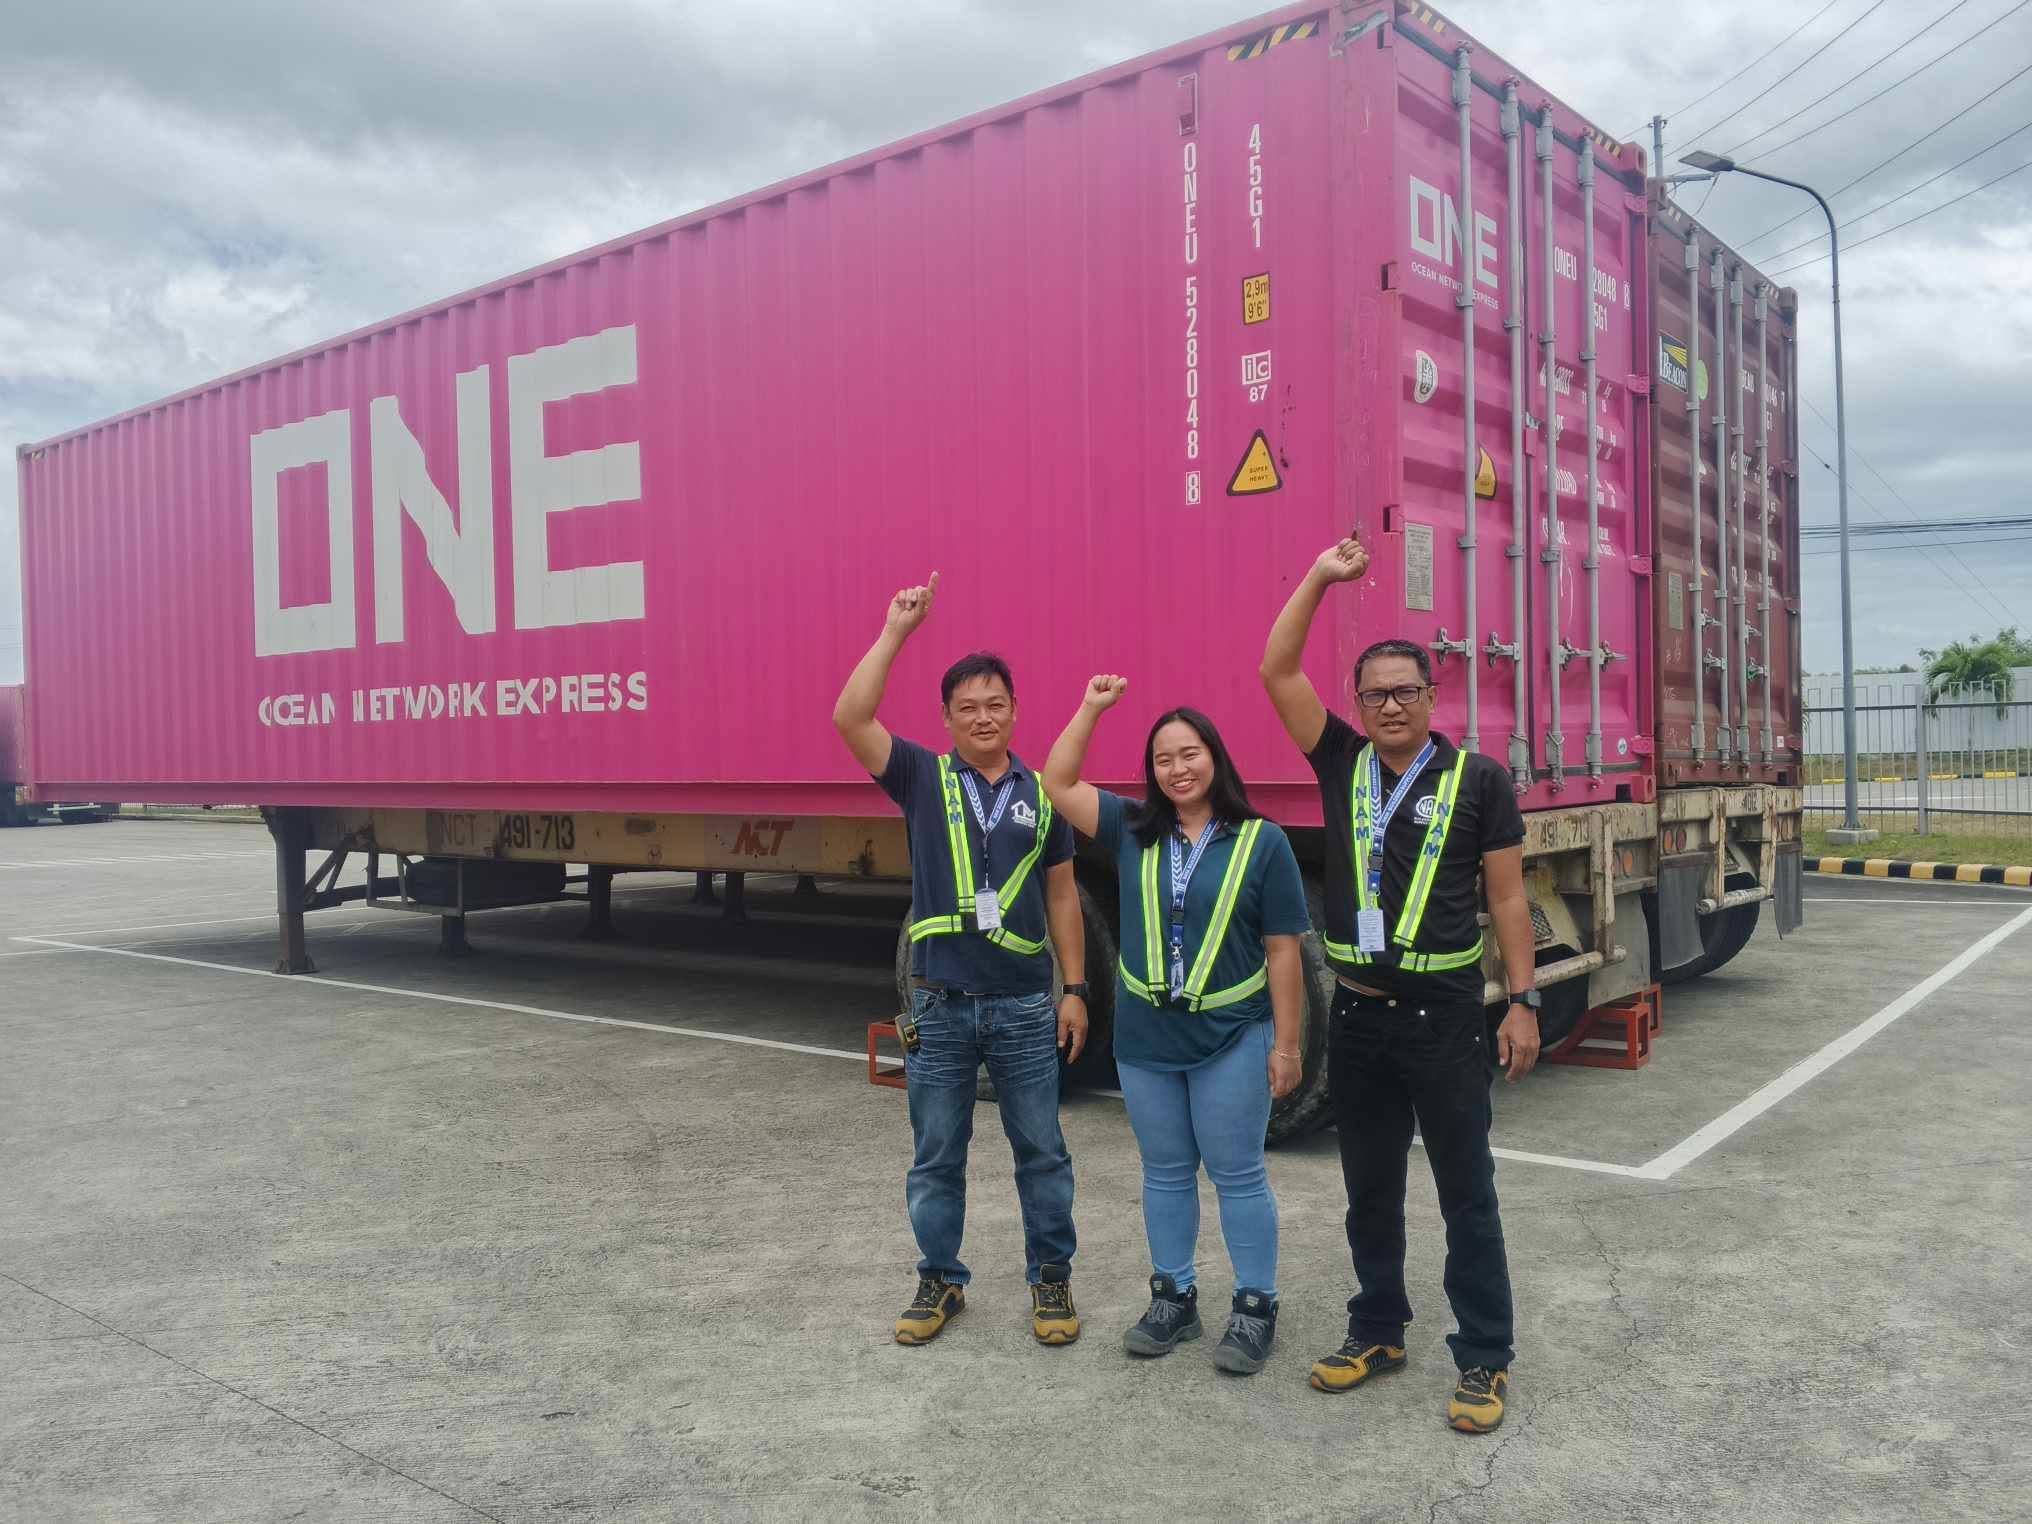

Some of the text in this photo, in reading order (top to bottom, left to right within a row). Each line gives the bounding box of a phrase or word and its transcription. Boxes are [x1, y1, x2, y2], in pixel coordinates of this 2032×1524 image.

[1249, 123, 1263, 248] 45G1
[1410, 174, 1498, 289] ONE
[1411, 261, 1437, 282] OCEAN
[1438, 273, 1463, 294] NETWO
[1554, 246, 1577, 281] ONEU
[1184, 142, 1199, 504] ONEU 528048 8
[1249, 384, 1268, 402] 87
[250, 324, 645, 657] ONE
[258, 694, 335, 727] OCEAN
[496, 671, 648, 716] EXPRESS
[1355, 785, 1370, 840] NAM
